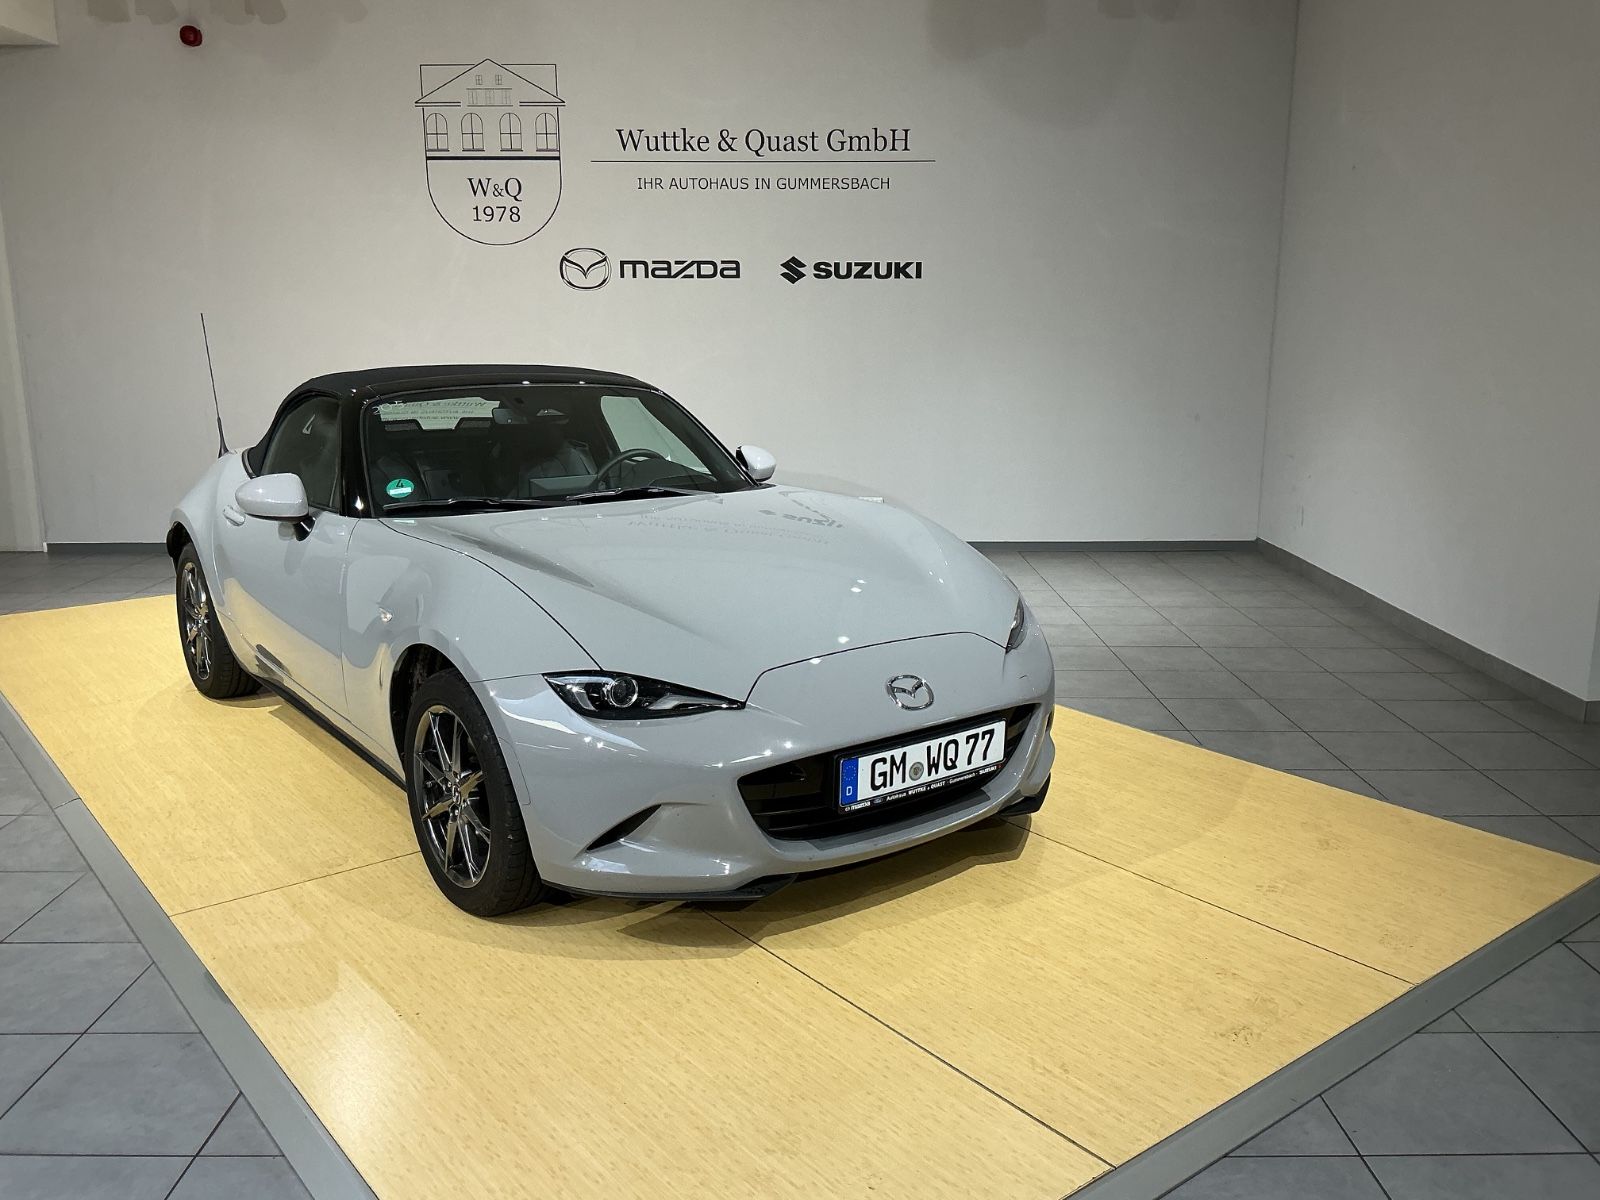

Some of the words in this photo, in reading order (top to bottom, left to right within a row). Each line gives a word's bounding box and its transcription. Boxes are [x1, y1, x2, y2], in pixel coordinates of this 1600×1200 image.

[615, 127, 710, 152] Wuttke
[717, 128, 738, 153] &
[744, 128, 820, 158] Quast
[826, 127, 912, 153] GmbH
[466, 177, 523, 202] W&Q
[637, 177, 665, 190] IHR
[669, 177, 749, 190] AUTOHAUS
[754, 177, 771, 190] IN
[776, 177, 890, 190] GUMMERSBACH
[472, 205, 521, 223] 1978
[619, 259, 741, 279] mazda
[812, 261, 923, 280] SUZUKI
[395, 479, 404, 488] 4
[870, 751, 907, 791] GM
[926, 739, 960, 777] WQ
[965, 728, 995, 766] 77
[845, 786, 853, 796] D
[930, 781, 946, 789] QUAST
